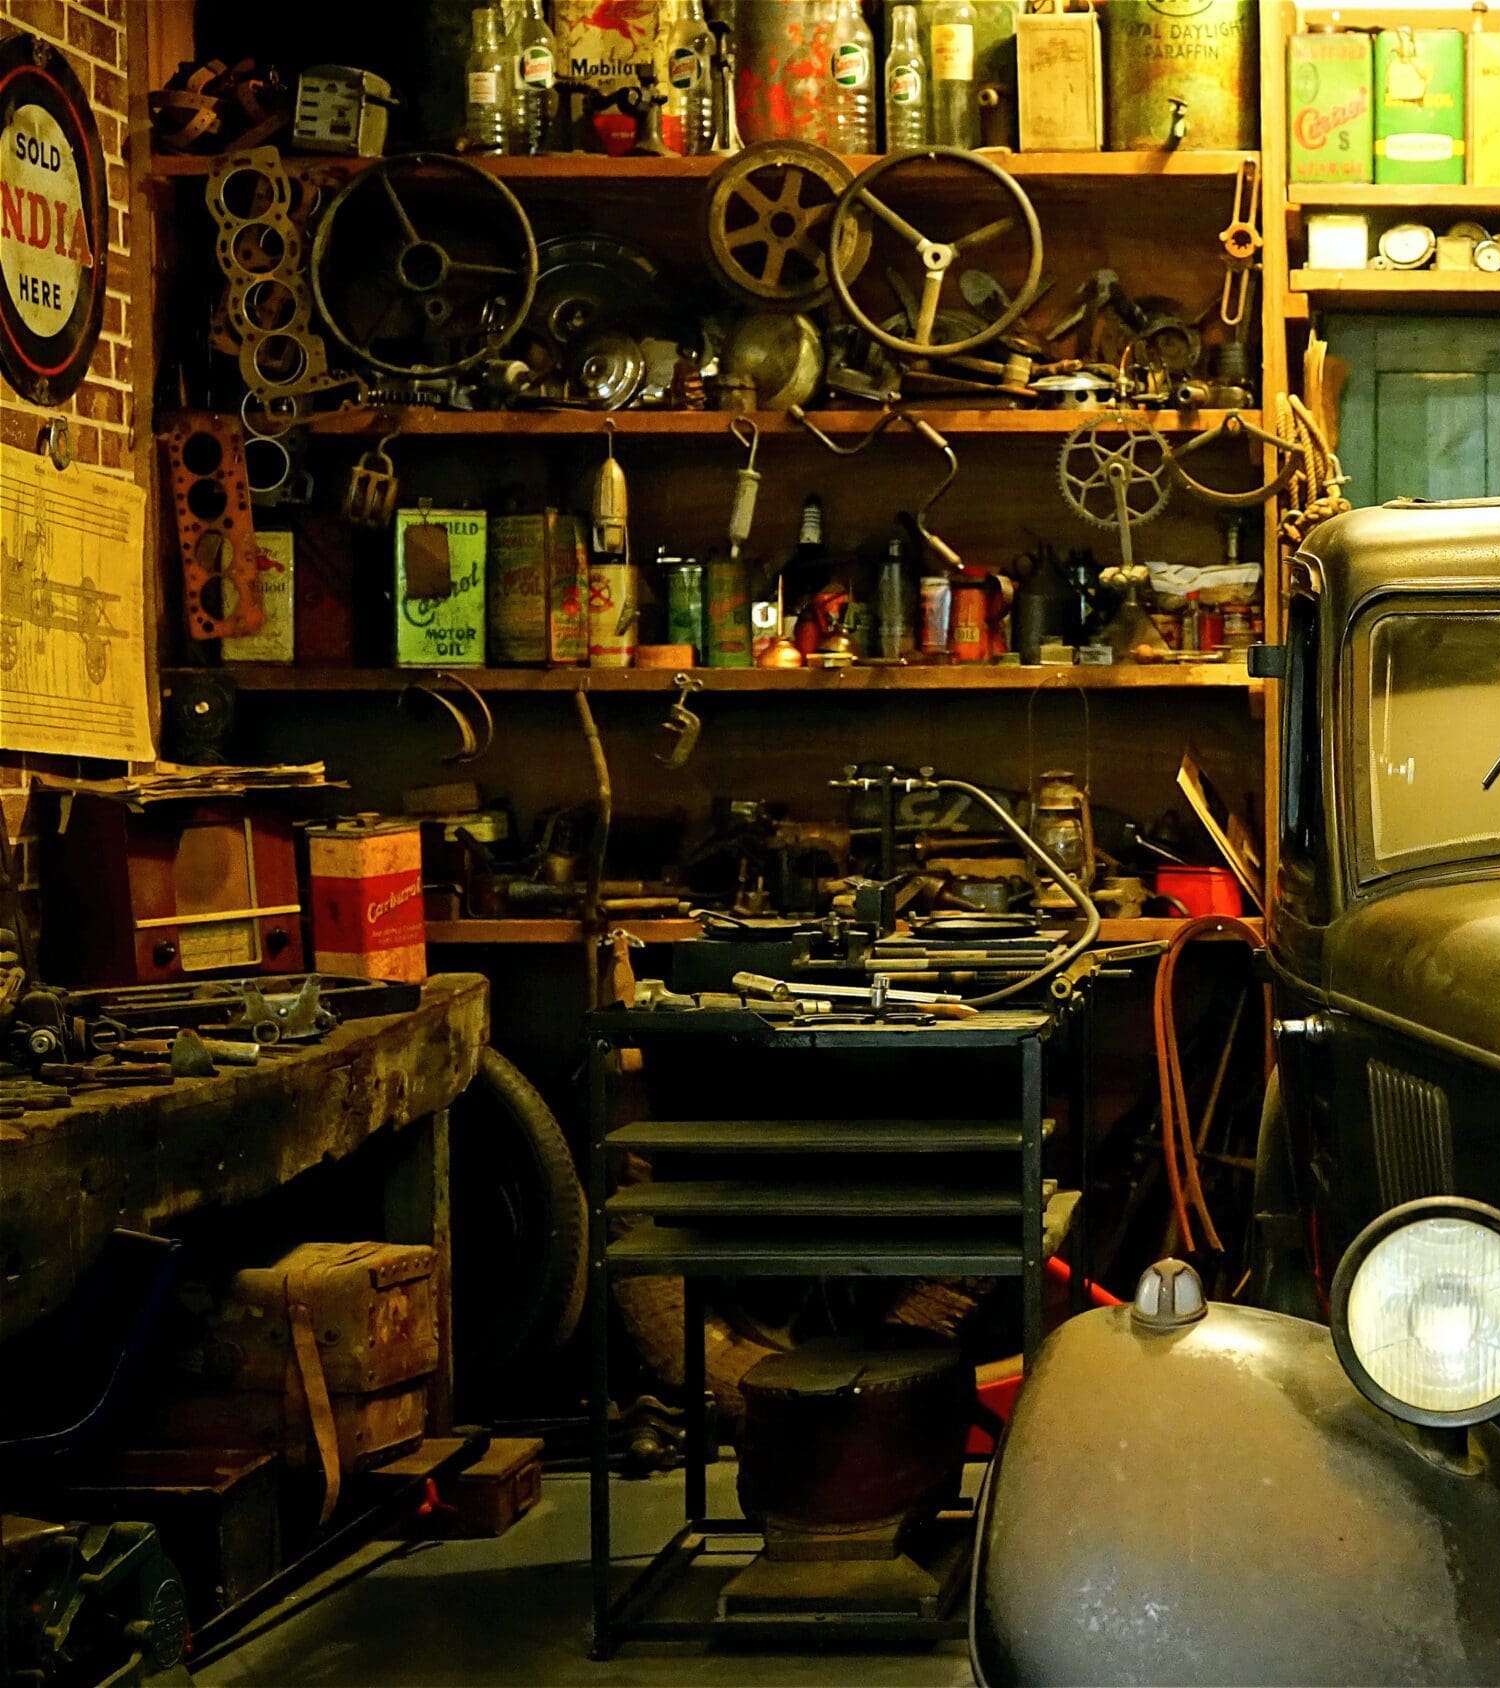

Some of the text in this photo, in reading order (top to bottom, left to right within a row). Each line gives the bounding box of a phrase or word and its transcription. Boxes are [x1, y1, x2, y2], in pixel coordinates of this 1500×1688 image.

[1144, 44, 1219, 60] PARAFFIN
[571, 58, 656, 76] Mobilo
[15, 132, 61, 172] SOLD
[18, 273, 62, 311] HERE
[425, 627, 476, 641] MOTOR
[436, 643, 465, 656] OIL
